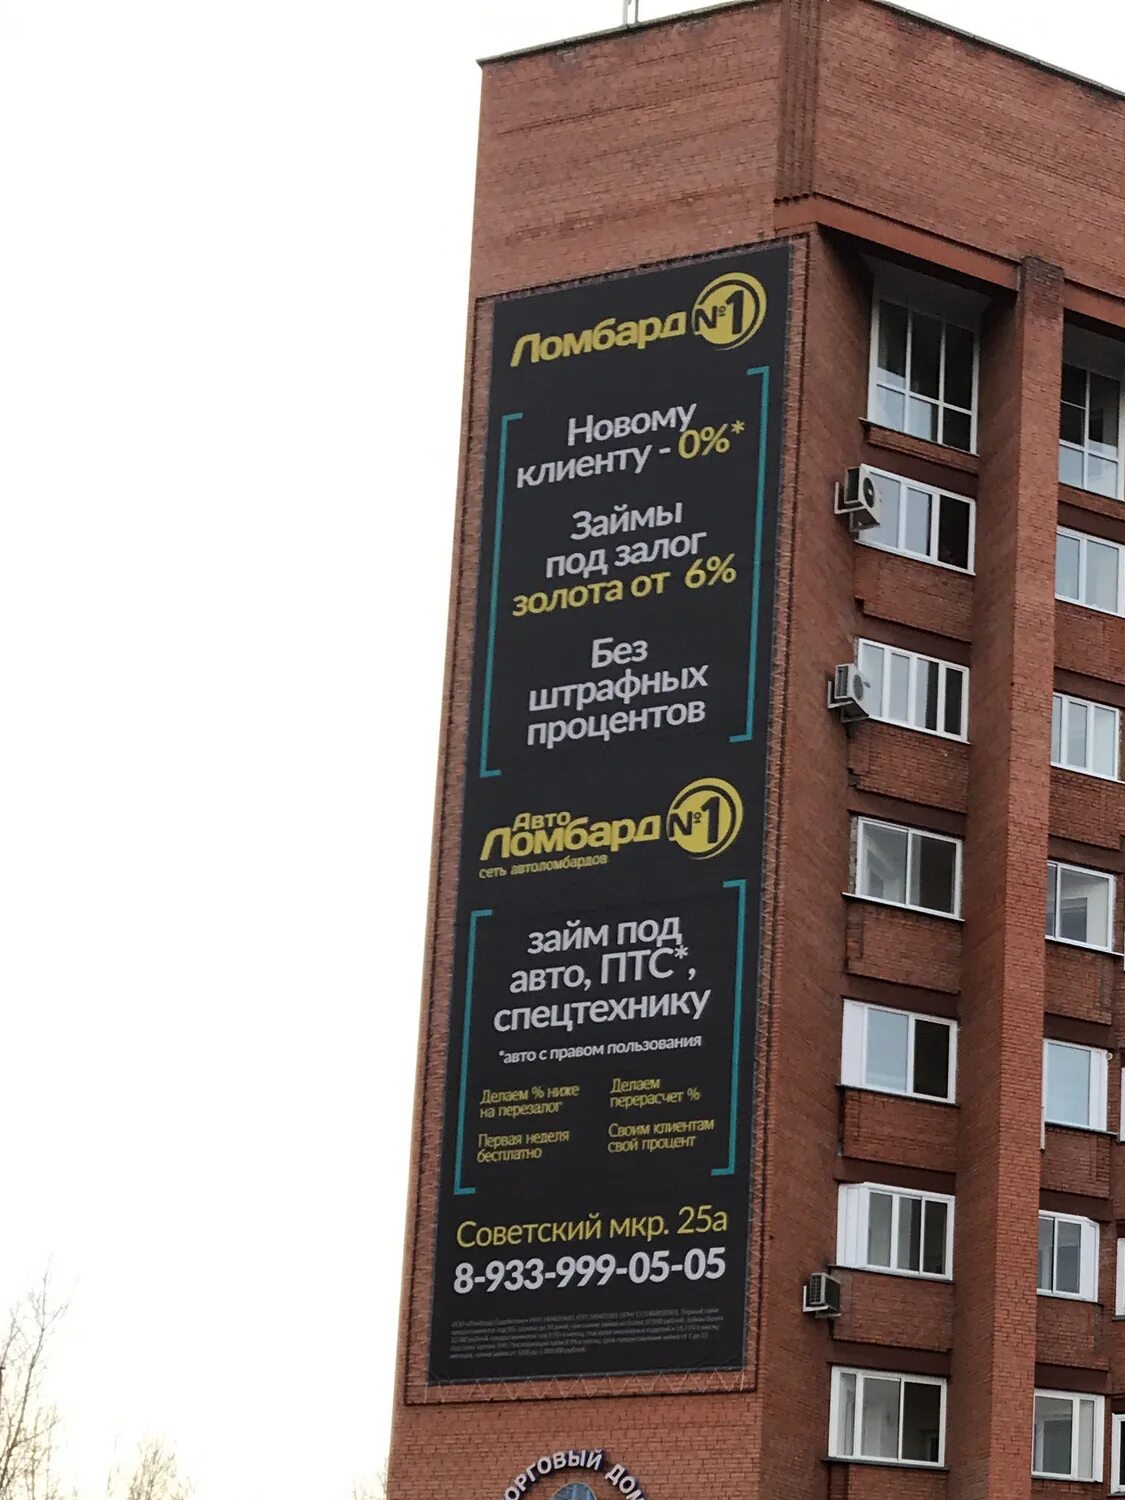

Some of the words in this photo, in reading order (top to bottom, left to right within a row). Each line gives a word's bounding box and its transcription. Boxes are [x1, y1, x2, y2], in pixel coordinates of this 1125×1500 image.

[510, 314, 687, 367] Ломбард
[567, 403, 697, 446] Новому
[517, 441, 652, 489] клиенту
[570, 503, 683, 541] Займы
[546, 540, 608, 578] под
[614, 530, 707, 568] залог
[512, 580, 623, 617] золота
[630, 572, 671, 599] от
[685, 553, 737, 590] 6%
[591, 636, 648, 669] Без
[528, 664, 709, 713] штрафных
[527, 700, 706, 748] процентов
[480, 813, 661, 861] Ломбард
[513, 811, 571, 831] Авто
[479, 865, 507, 879] сеть
[510, 854, 608, 876] автоломбардов
[527, 920, 608, 956] займ
[617, 916, 683, 949] под
[509, 962, 592, 995] авто,
[494, 988, 711, 1034] спецтехнику
[538, 1049, 548, 1061] с
[550, 1044, 604, 1063] правом
[607, 1034, 702, 1056] пользования
[480, 1088, 529, 1105] Делаем
[531, 1086, 545, 1099] %
[547, 1084, 580, 1098] ниже
[611, 1077, 661, 1093] Делаем
[687, 1086, 701, 1100] %
[480, 1106, 495, 1118] на
[608, 1121, 650, 1138] Своим
[653, 1118, 715, 1134] клиентам
[476, 1148, 543, 1164] бесплатно
[478, 1133, 523, 1149] Первая
[526, 1129, 570, 1144] неделя
[607, 1137, 639, 1153] свой
[641, 1135, 696, 1152] процент
[456, 1211, 602, 1249] Советский
[609, 1209, 669, 1242] мкр.
[678, 1203, 728, 1235] 25а
[453, 1246, 726, 1295] 8-933-999-05-05
